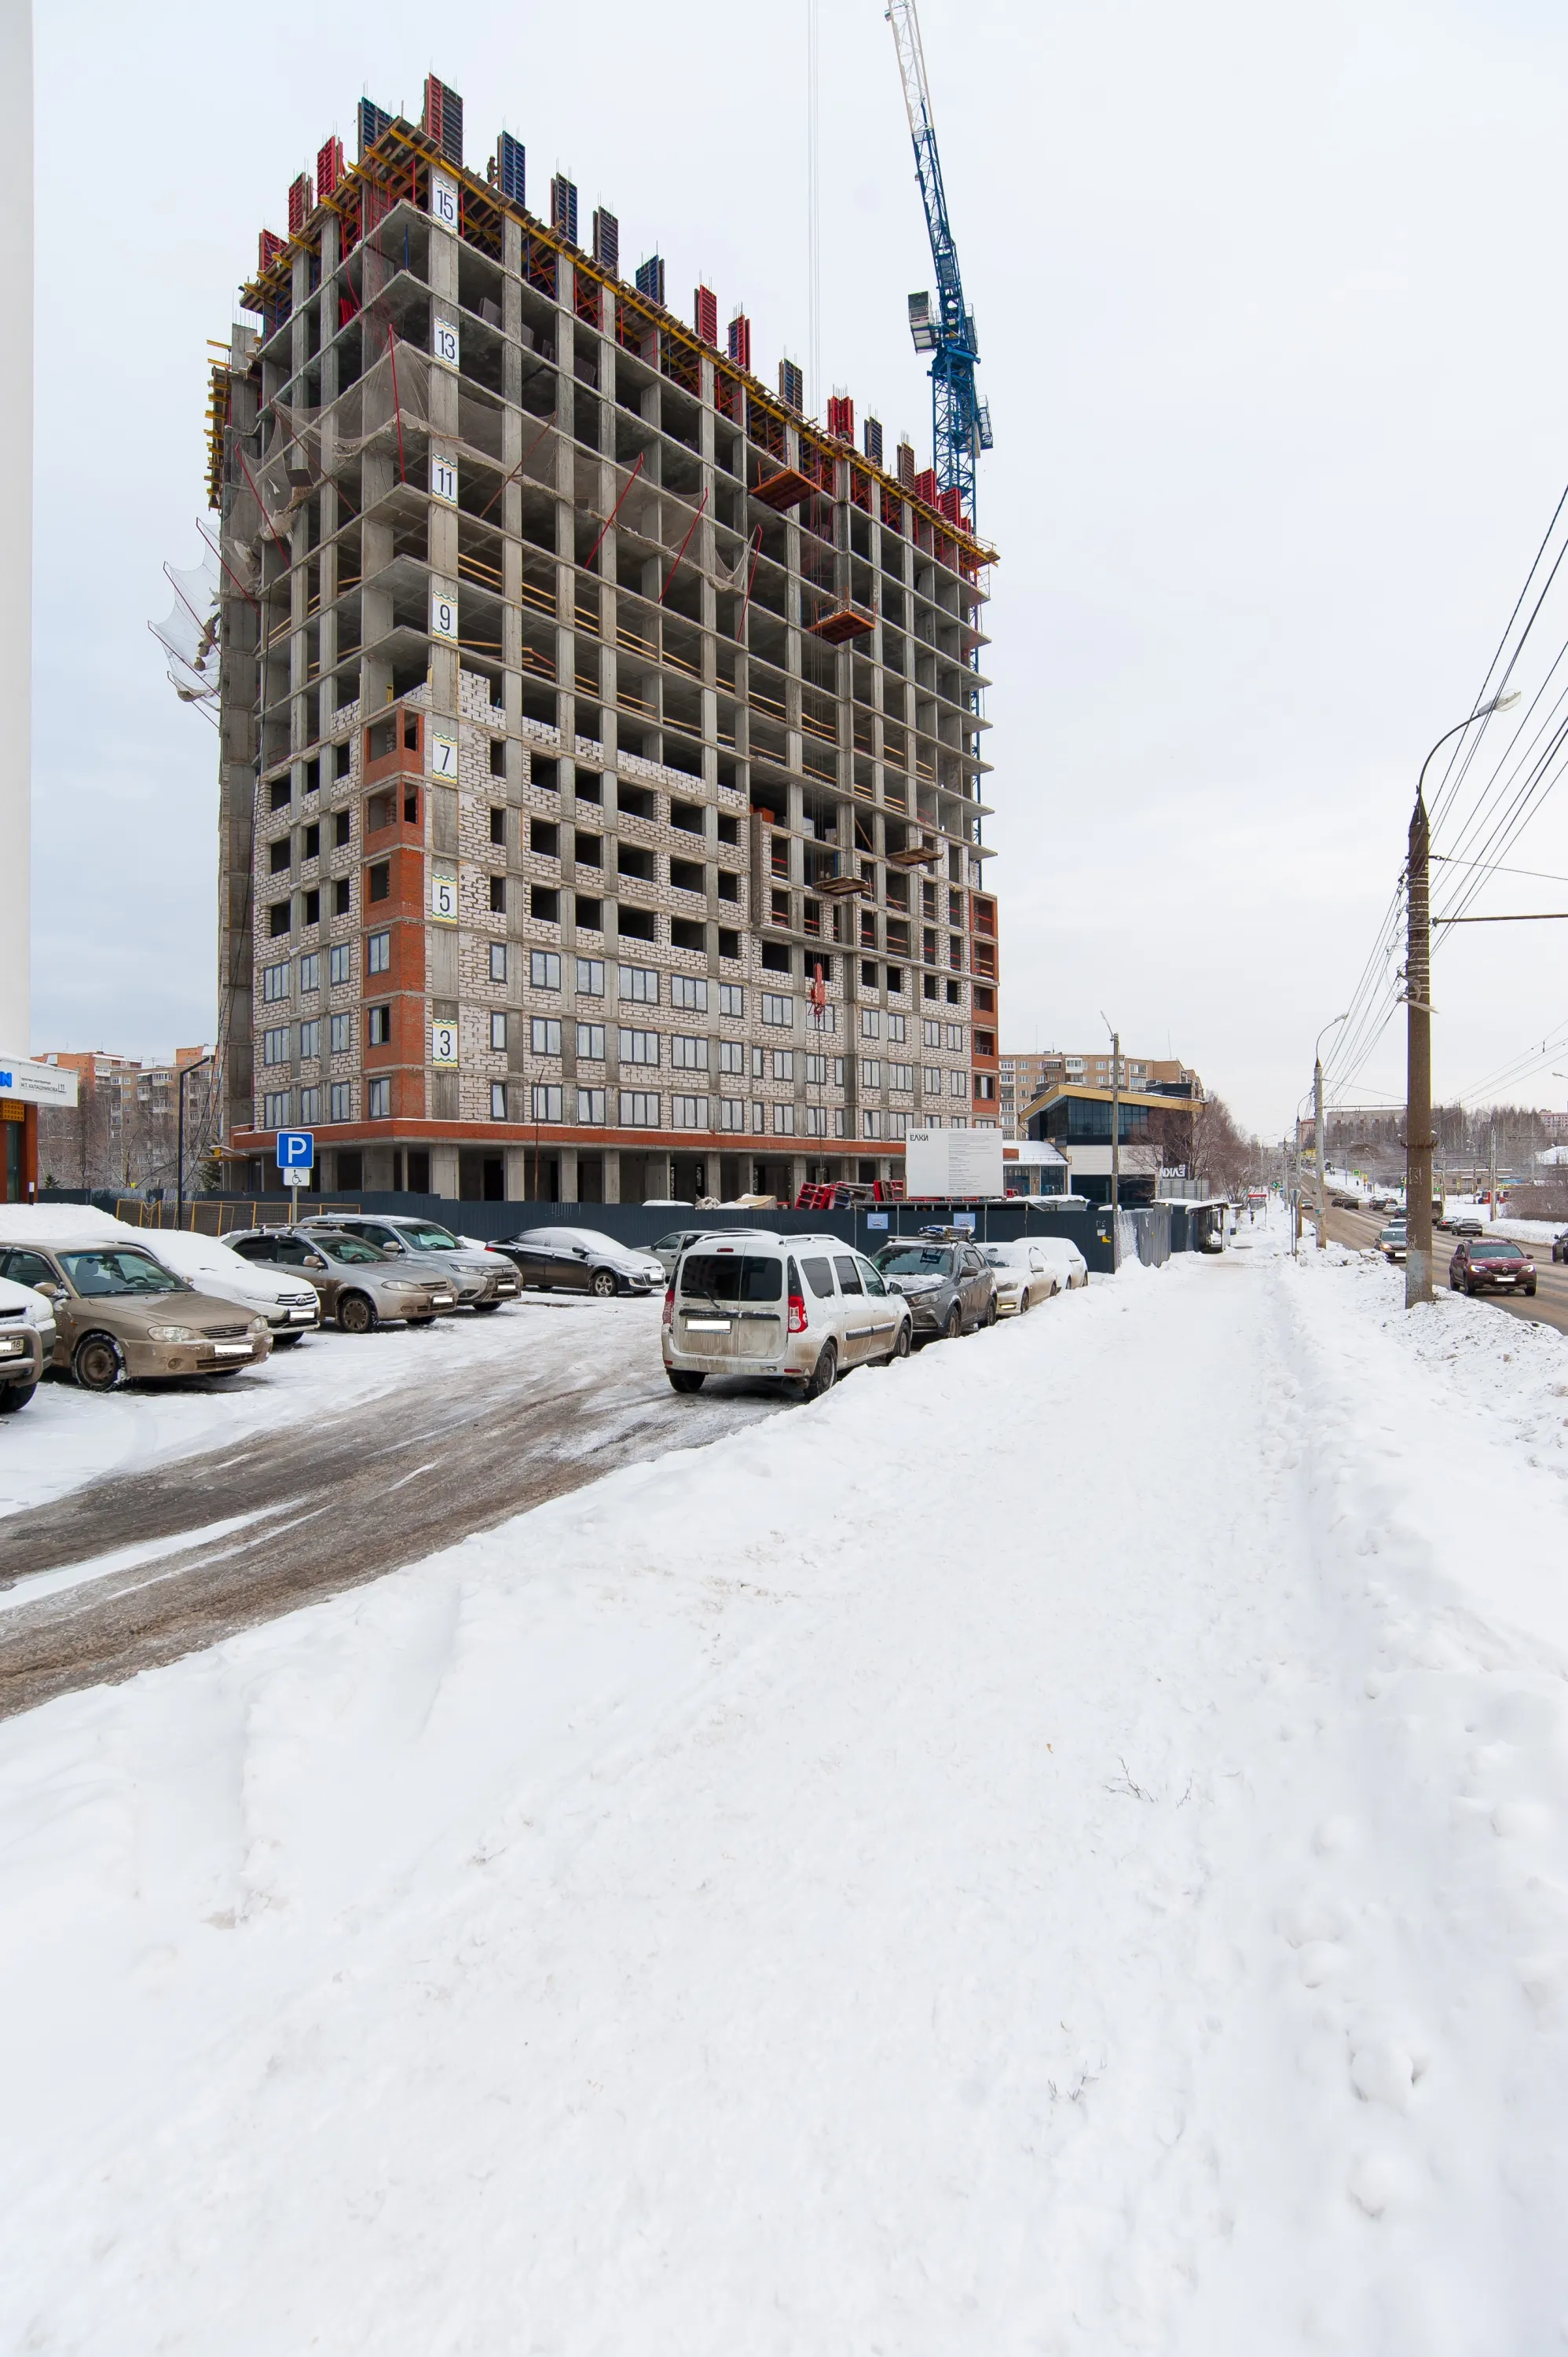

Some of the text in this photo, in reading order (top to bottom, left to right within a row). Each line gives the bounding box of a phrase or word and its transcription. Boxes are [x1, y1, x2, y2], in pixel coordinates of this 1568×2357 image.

[437, 189, 453, 221] 15
[438, 329, 456, 360] 13
[438, 467, 452, 497] 11
[440, 604, 451, 631] 9
[440, 744, 450, 771] 7
[440, 885, 450, 912] 5
[440, 1029, 451, 1057] 3
[288, 1137, 307, 1164] P
